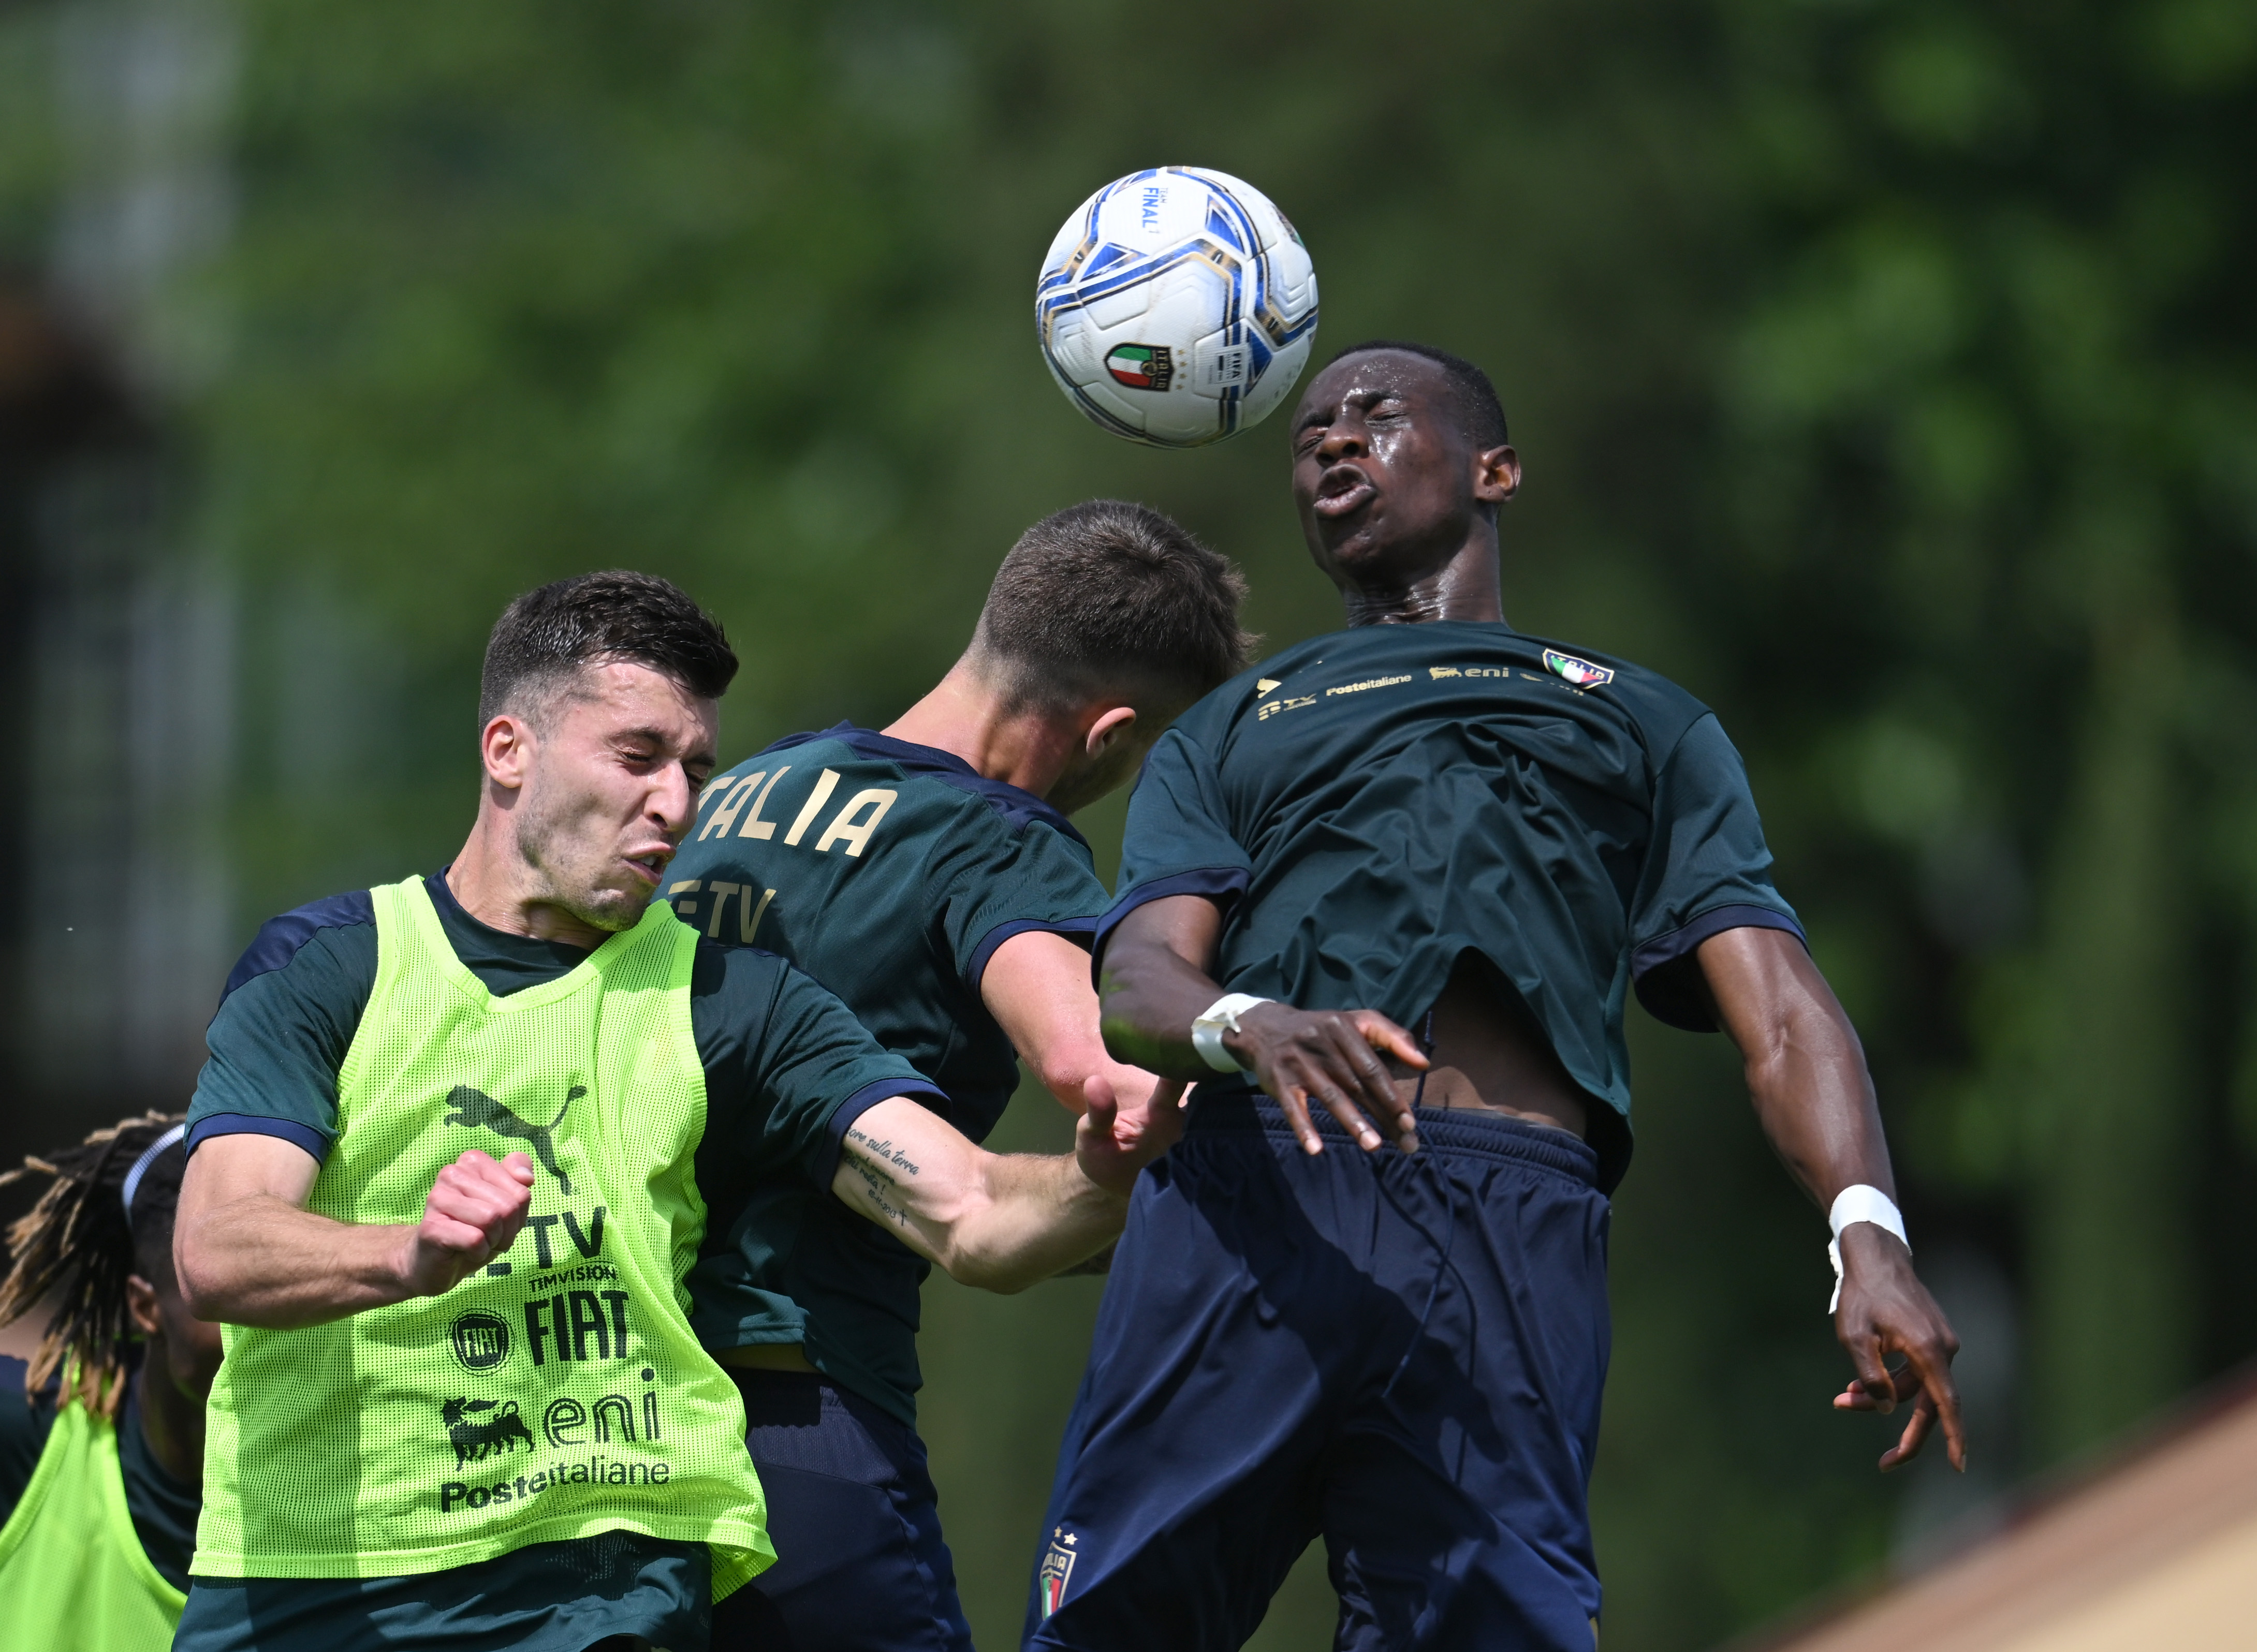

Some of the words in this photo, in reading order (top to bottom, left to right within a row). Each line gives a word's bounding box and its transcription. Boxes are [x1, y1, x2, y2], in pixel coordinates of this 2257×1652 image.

[1142, 187, 1159, 228] FINAL
[1160, 187, 1168, 203] TEAM
[1156, 349, 1169, 389] ITALIA
[1326, 675, 1412, 696] Posteitaliane
[1464, 668, 1509, 678] eni
[697, 766, 898, 858] TALIA
[847, 1128, 867, 1142] ore
[866, 1140, 892, 1159] sulla
[891, 1150, 919, 1175] terra
[529, 1263, 617, 1293] TIMVISION
[462, 1326, 499, 1358] FIAT
[524, 1290, 629, 1367] FIAT
[544, 1367, 661, 1448] eni
[441, 1455, 670, 1513] Posteitaliane
